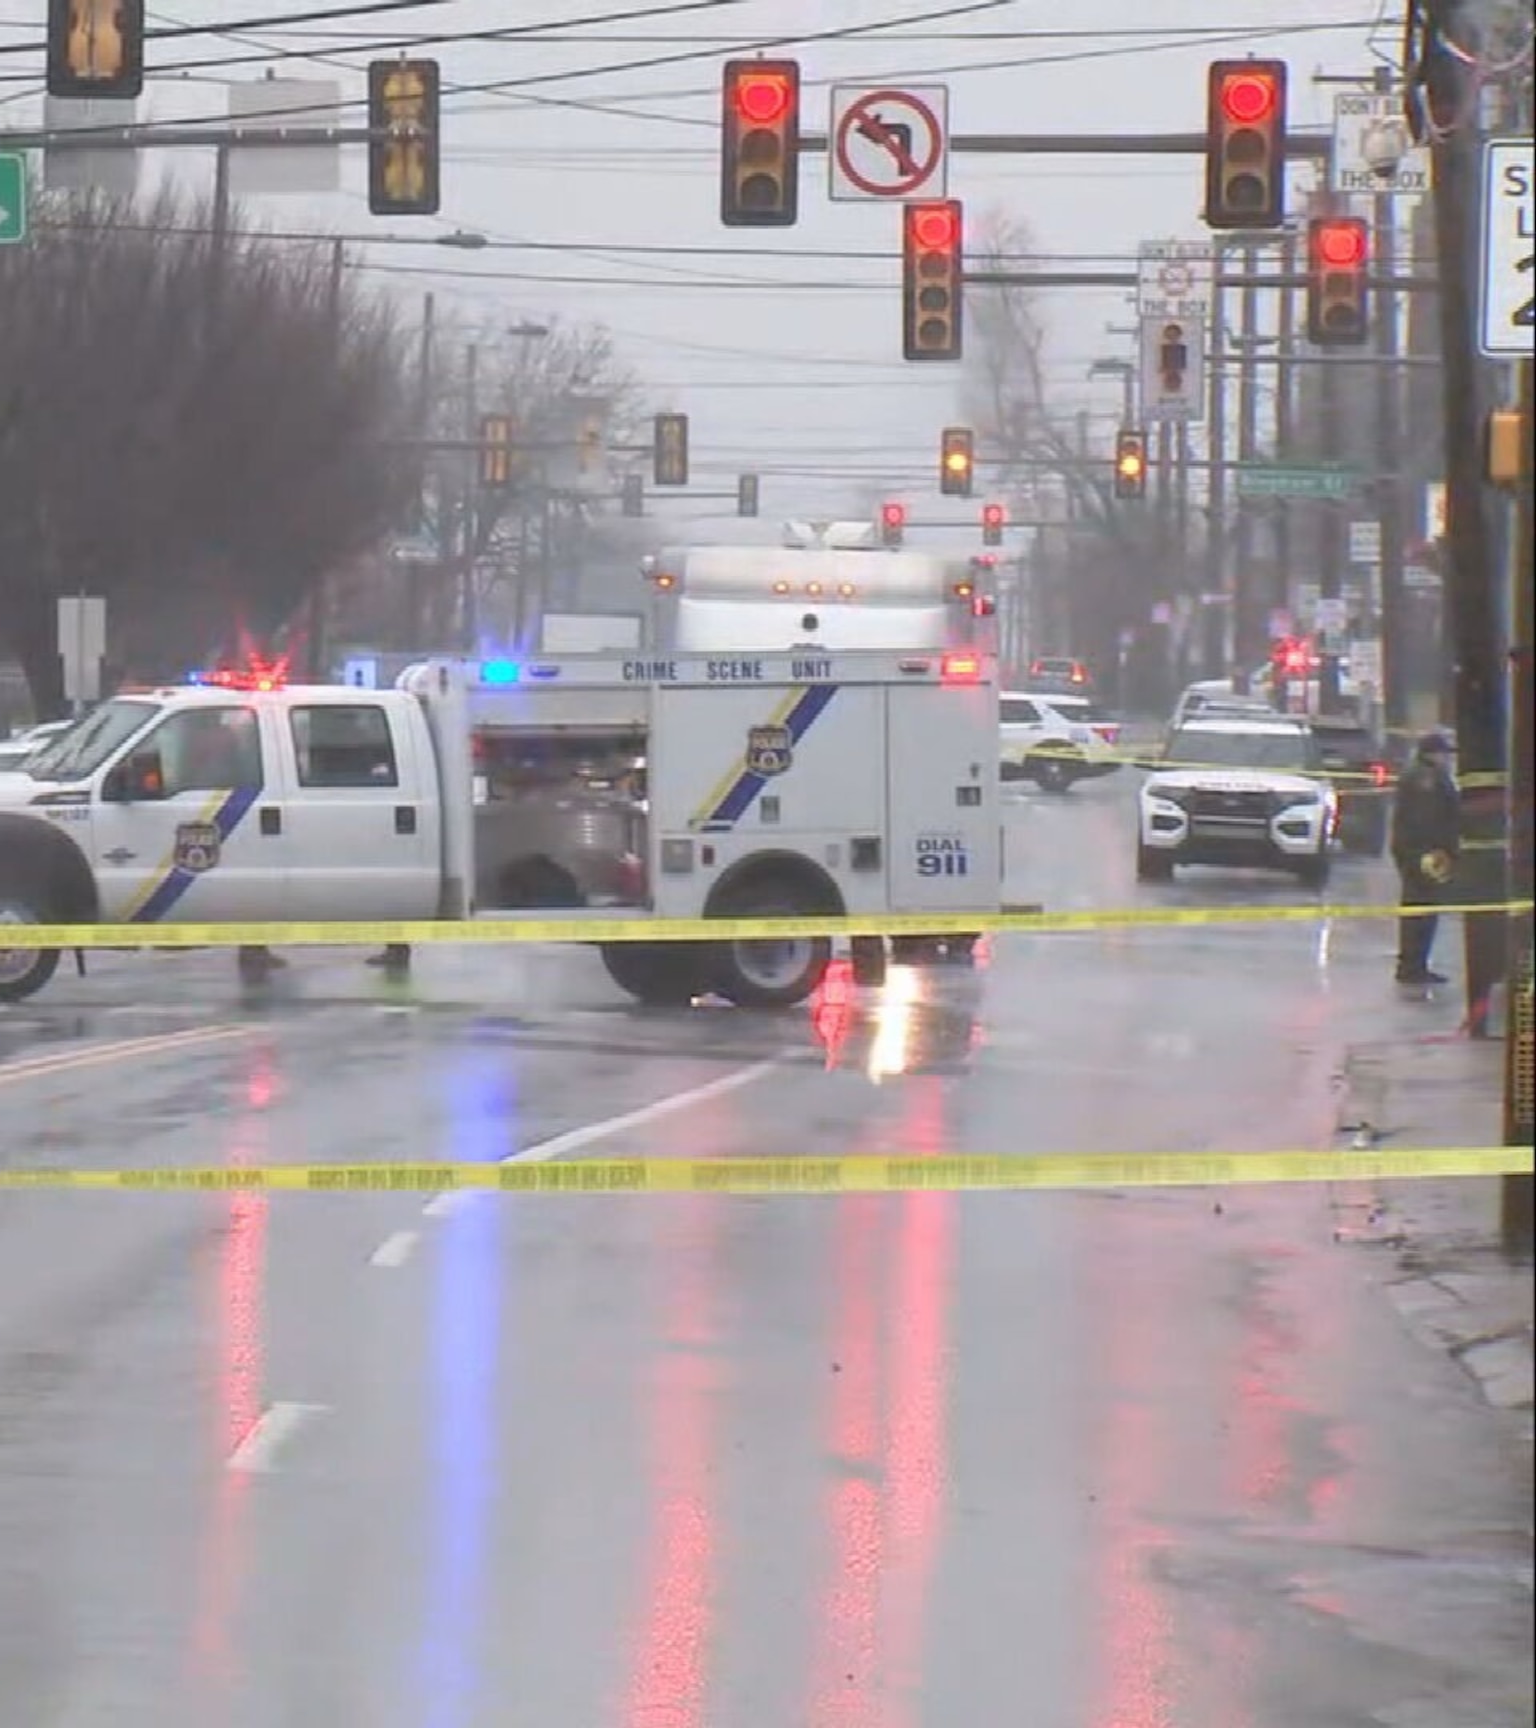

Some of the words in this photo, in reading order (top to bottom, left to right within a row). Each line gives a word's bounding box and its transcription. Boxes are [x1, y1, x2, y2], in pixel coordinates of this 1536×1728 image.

[1341, 170, 1376, 188] THE
[622, 661, 678, 681] CRIME
[707, 660, 764, 680] SCENE
[792, 659, 832, 678] UNIT
[916, 839, 966, 853] DIAL
[917, 854, 966, 877] 911
